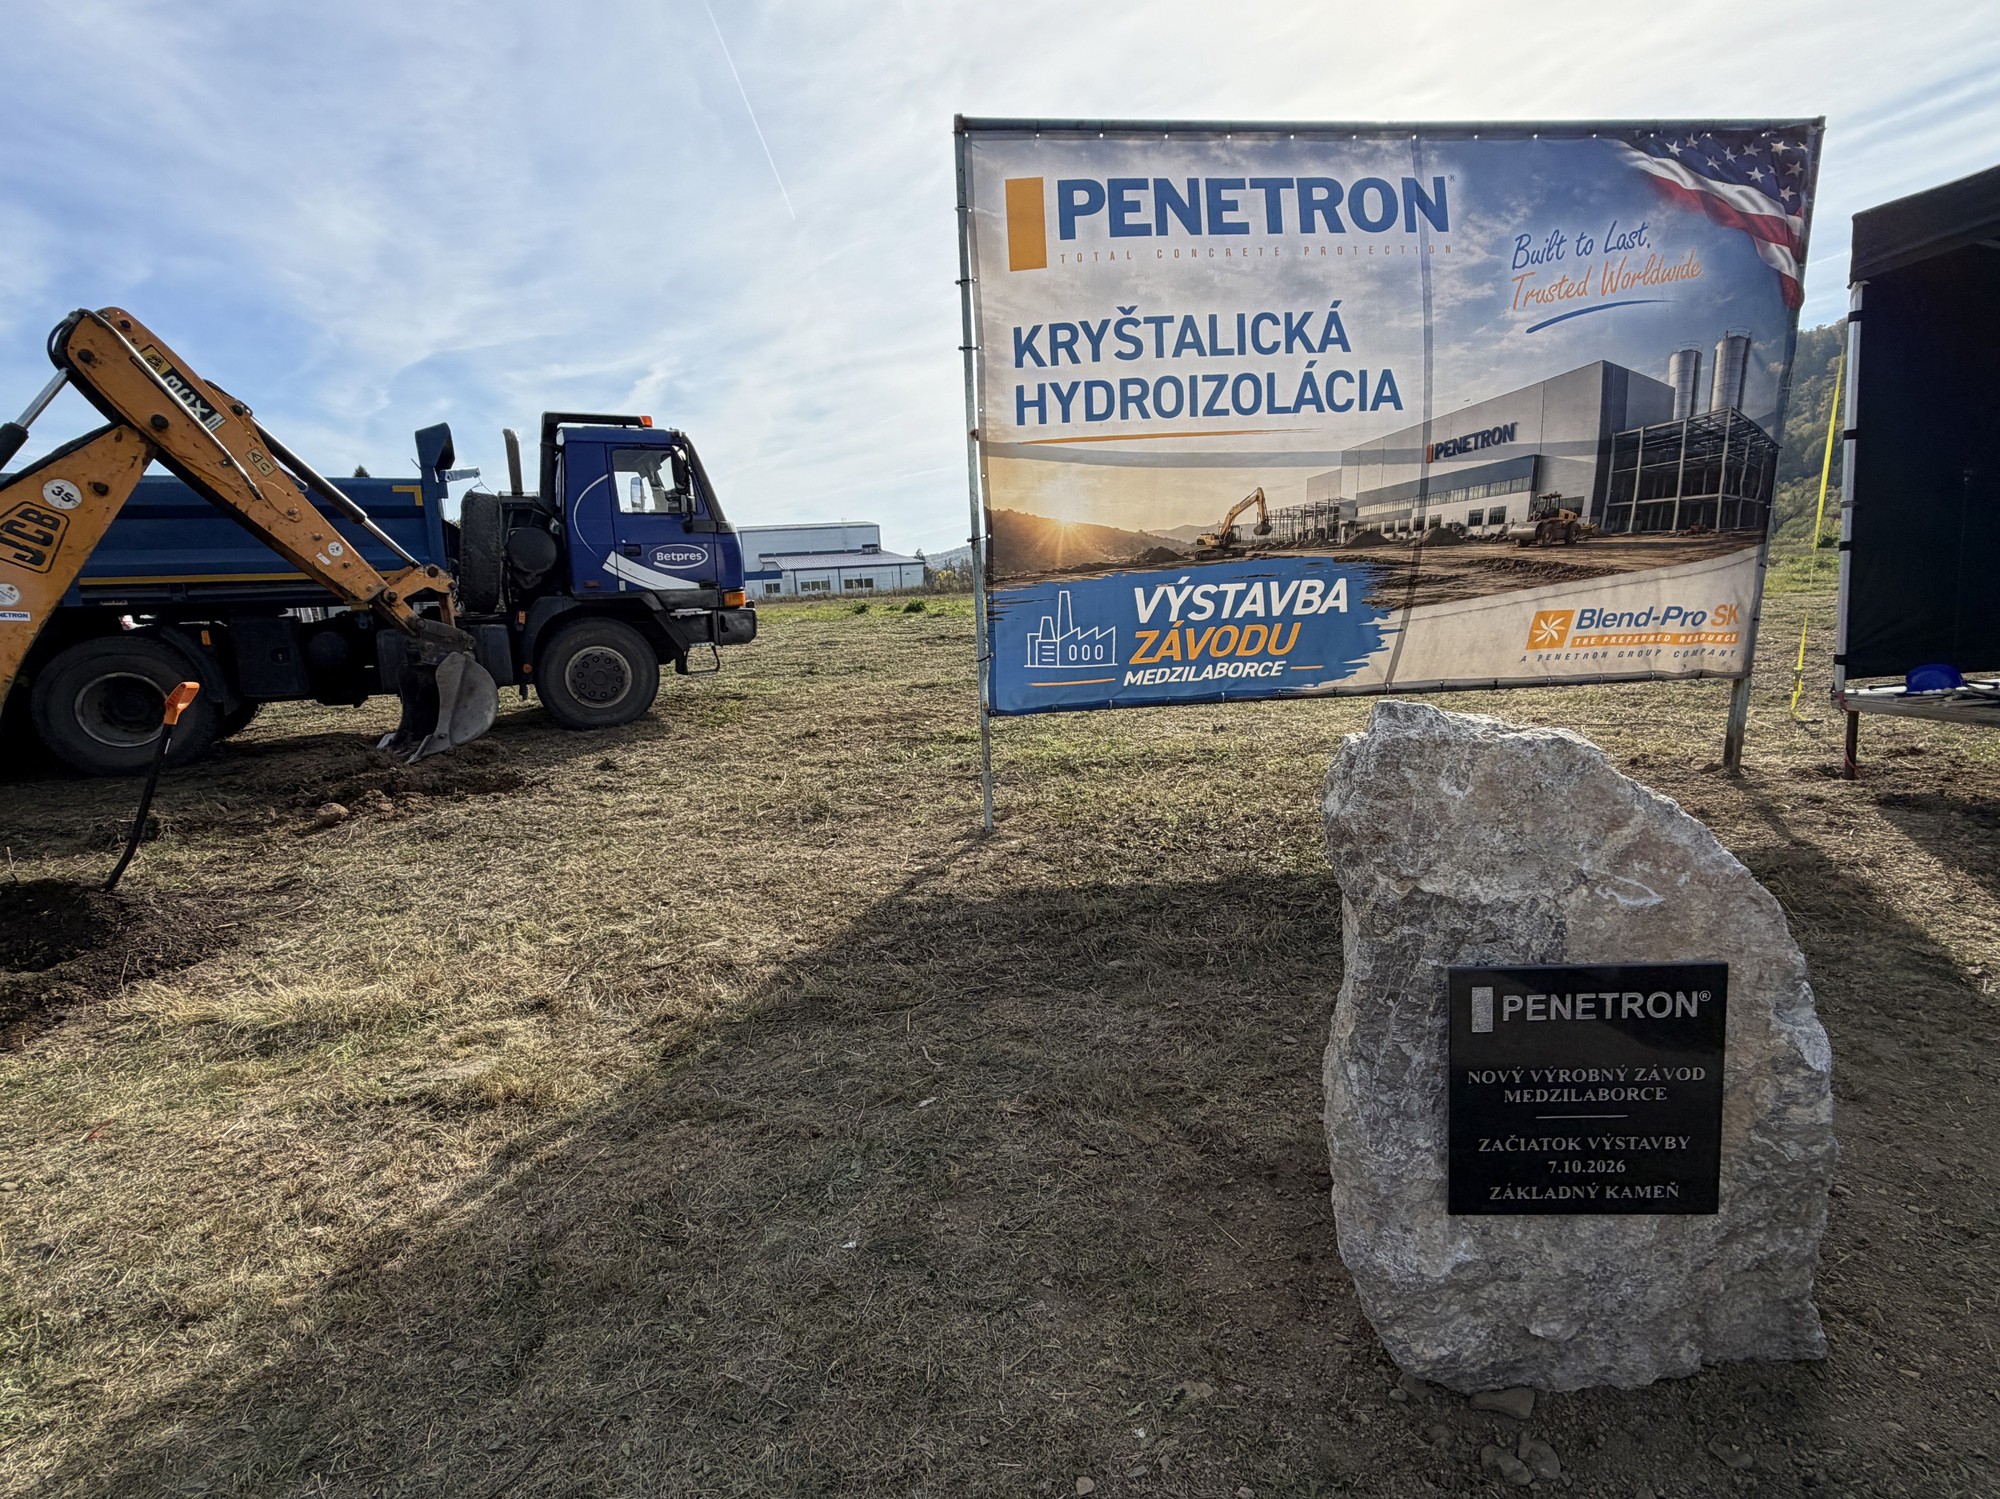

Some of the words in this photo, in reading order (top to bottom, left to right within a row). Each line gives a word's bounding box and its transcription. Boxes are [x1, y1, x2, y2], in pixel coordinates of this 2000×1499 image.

[1061, 250, 1132, 264] TOTAL
[1157, 246, 1280, 259] CONCRETE
[1304, 244, 1451, 256] PROTECTION
[1512, 229, 1567, 270] Built
[1576, 231, 1594, 257] to
[1604, 220, 1651, 253] Last.
[1511, 266, 1593, 310] Trusted
[1601, 248, 1701, 297] Worldwide
[1013, 300, 1351, 368] KRYŠTALICKÁ
[1015, 360, 1403, 425] HYDROIZOLÁCIA
[51, 486, 74, 503] 35
[0, 507, 61, 566] JCB
[656, 551, 702, 562] Betpres
[1134, 576, 1348, 624] VÝSTAVBA
[1576, 606, 1707, 630] Blend-Pro
[1710, 604, 1739, 627] SK
[1129, 620, 1301, 665] ZÁVODU
[1575, 637, 1597, 646] THE
[1603, 634, 1671, 644] PREFERRED
[1679, 632, 1737, 643] RESOURCE
[1537, 651, 1608, 662] PENETRON
[1618, 648, 1662, 659] GROUP
[1673, 648, 1737, 659] COMPANY
[1123, 660, 1287, 687] MEDZILABORCE
[1468, 1066, 1524, 1084] NOVÝ
[1530, 1064, 1628, 1083] VÝROBNÝ
[1634, 1064, 1706, 1082] ZÁVOD
[1504, 1086, 1668, 1103] MEDZILABORCE
[1478, 1135, 1582, 1152] ZAČIATOK
[1588, 1133, 1691, 1150] VÝSTAVBY
[1548, 1159, 1626, 1174] 7.10.2026
[1490, 1183, 1600, 1200] ZÁKLADNÝ
[1605, 1181, 1680, 1199] KAMEŇ
